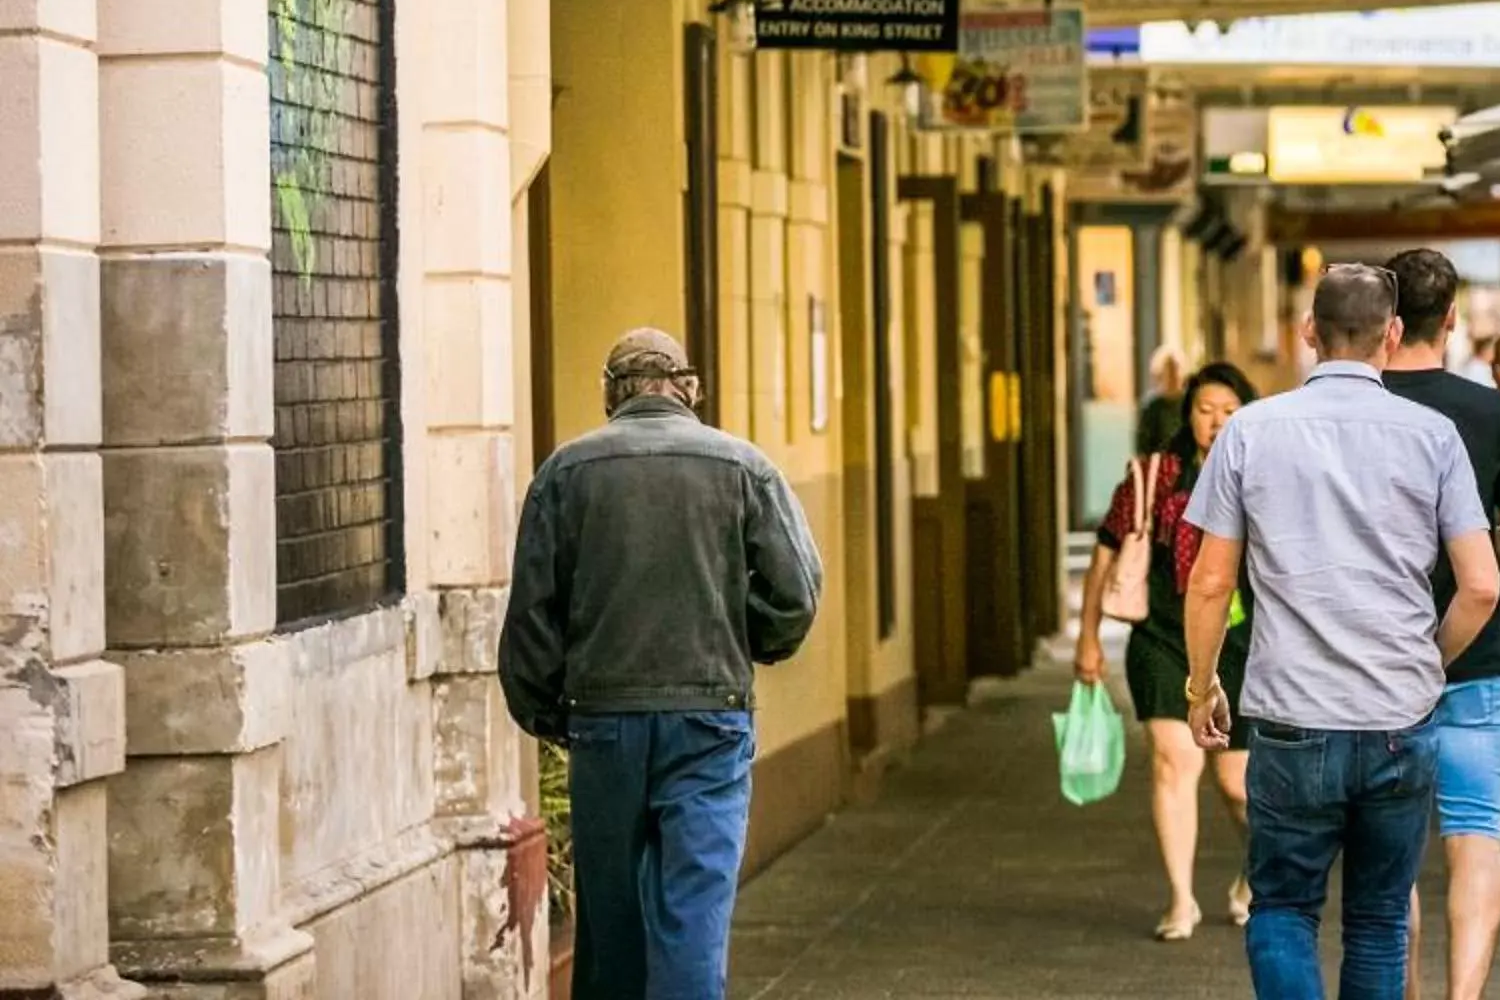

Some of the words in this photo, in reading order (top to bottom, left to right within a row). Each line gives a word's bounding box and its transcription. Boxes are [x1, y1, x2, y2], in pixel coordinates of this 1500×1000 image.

[758, 21, 811, 37] ENTRY
[814, 22, 838, 38] ON
[841, 22, 880, 39] KING
[883, 24, 944, 40] STREET
